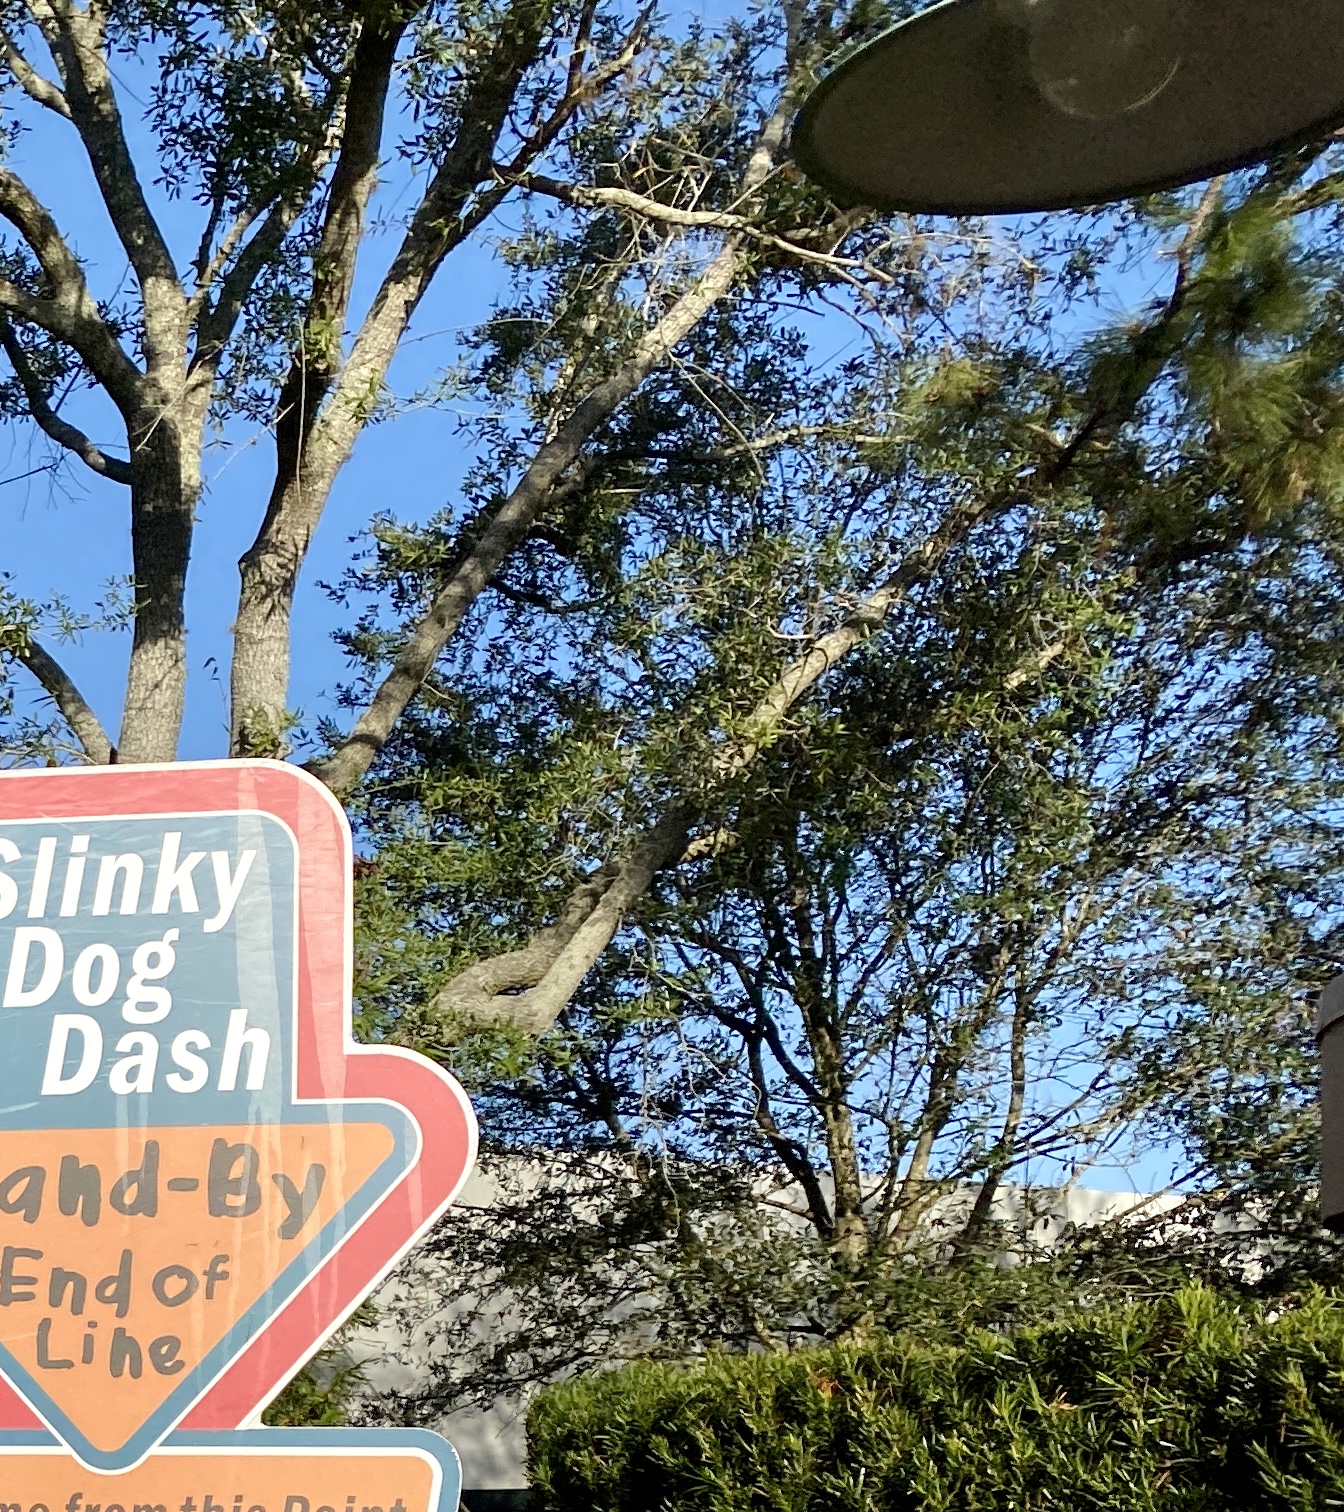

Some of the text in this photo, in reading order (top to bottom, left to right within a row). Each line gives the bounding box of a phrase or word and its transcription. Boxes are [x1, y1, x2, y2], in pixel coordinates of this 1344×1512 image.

[3, 926, 180, 1024] Dog
[41, 1009, 270, 1096] Dash
[152, 1254, 230, 1307] of
[36, 1317, 186, 1379] Line
